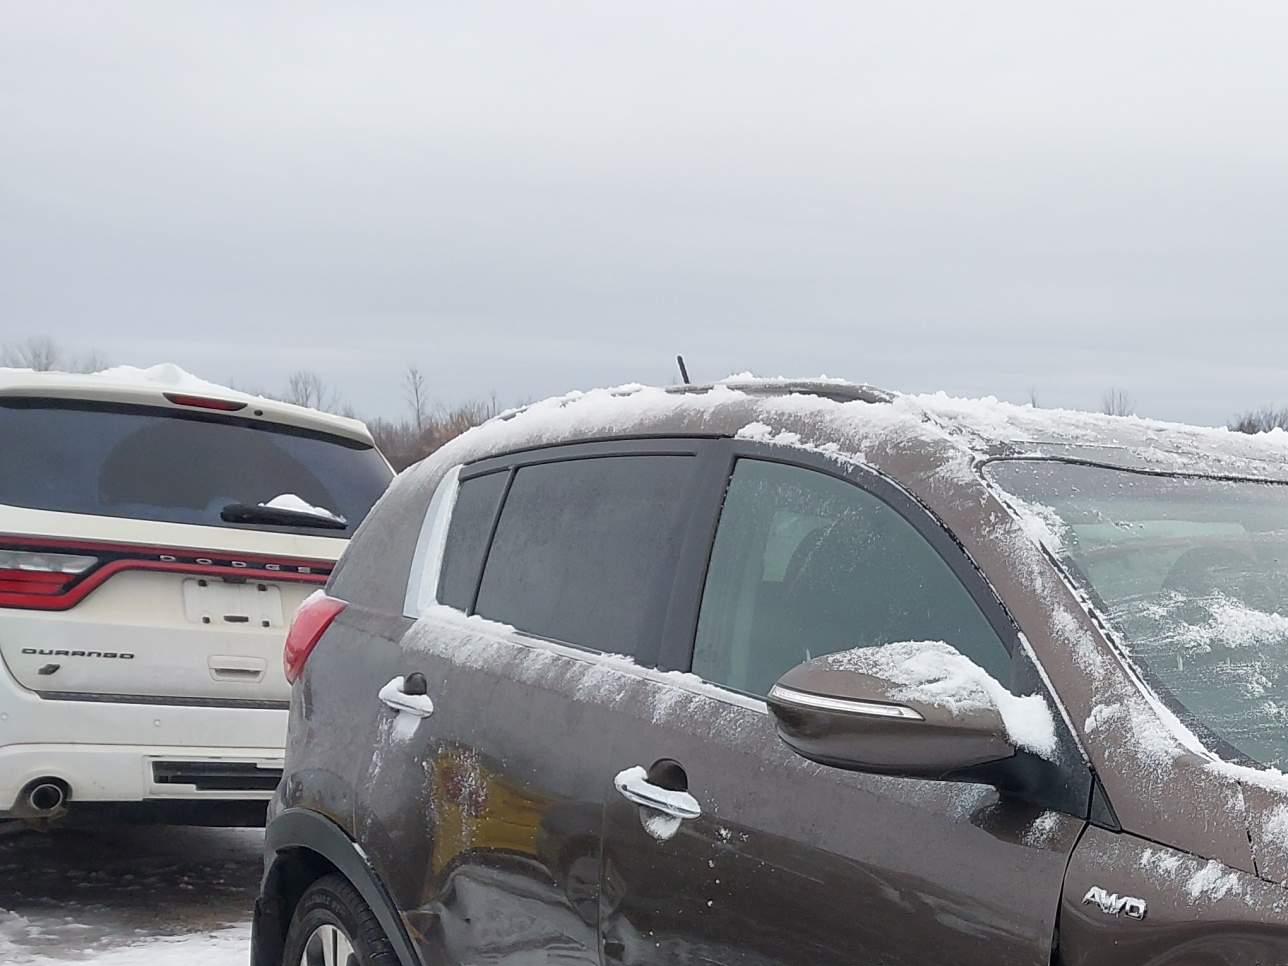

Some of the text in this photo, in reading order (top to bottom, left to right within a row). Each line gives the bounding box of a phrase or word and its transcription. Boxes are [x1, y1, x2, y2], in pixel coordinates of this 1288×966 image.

[159, 554, 311, 573] DODGE
[21, 648, 135, 659] DURANGO
[1081, 885, 1146, 920] AWD
